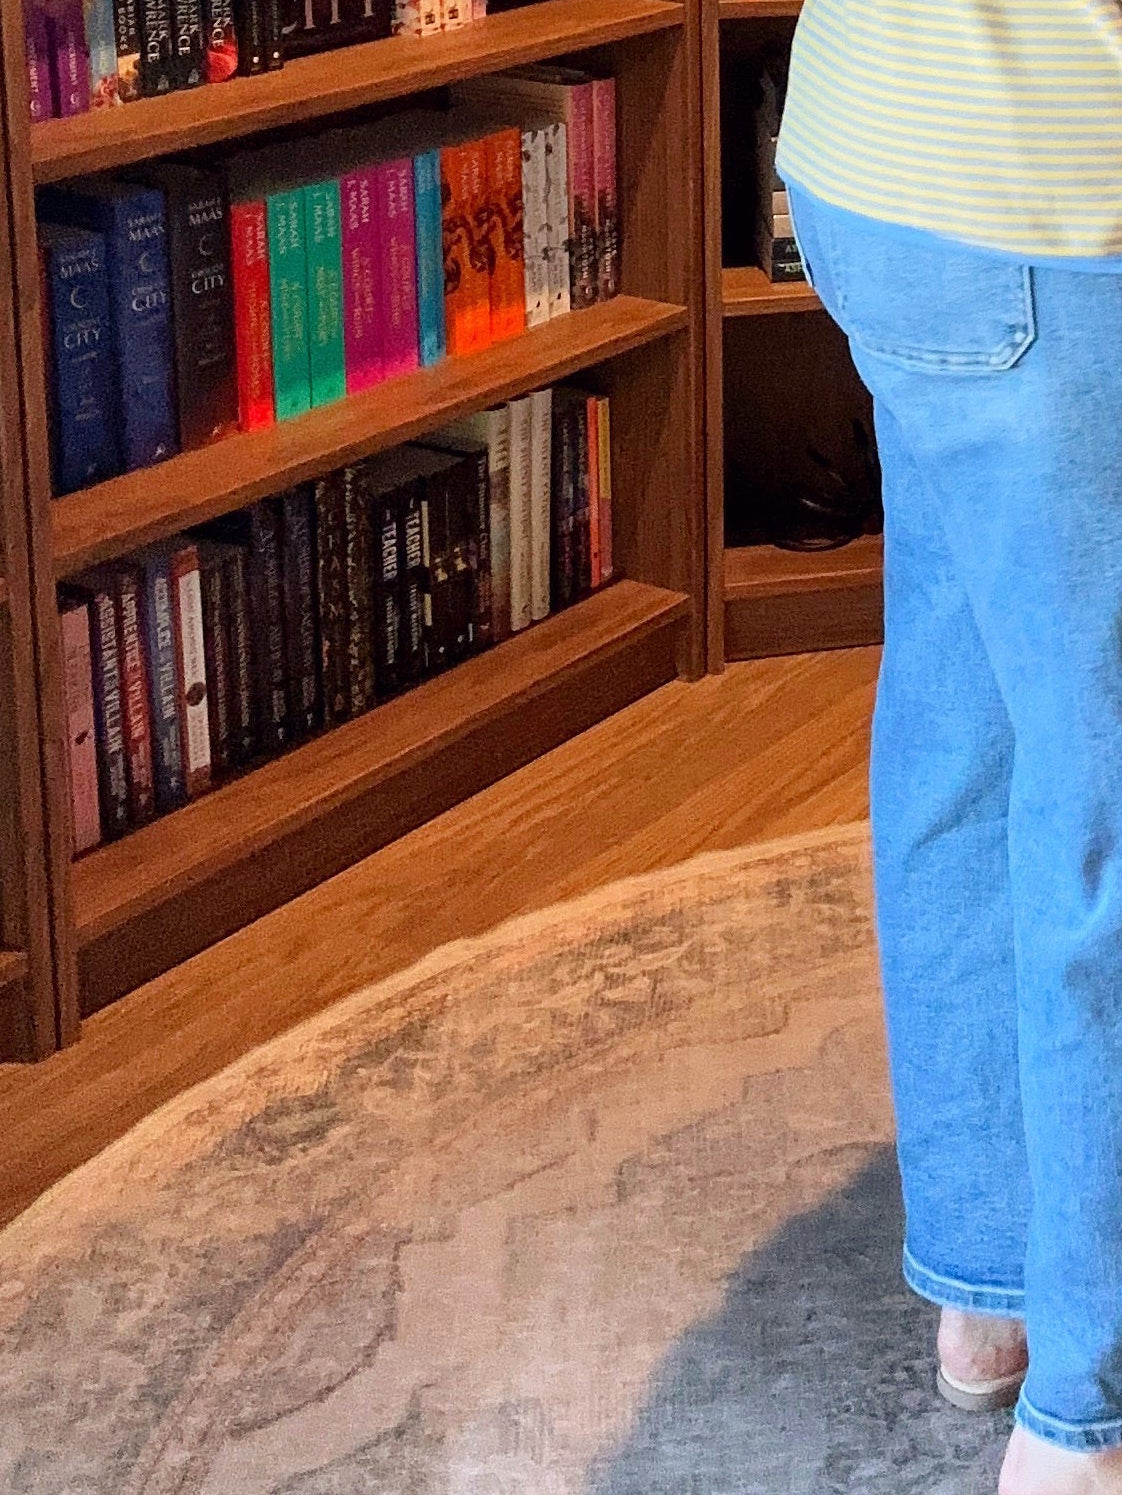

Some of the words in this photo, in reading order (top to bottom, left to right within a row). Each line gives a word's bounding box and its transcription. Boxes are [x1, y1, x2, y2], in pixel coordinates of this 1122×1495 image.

[190, 274, 224, 295] CITY
[382, 522, 397, 581] TEACHER
[405, 511, 421, 569] TEACHER
